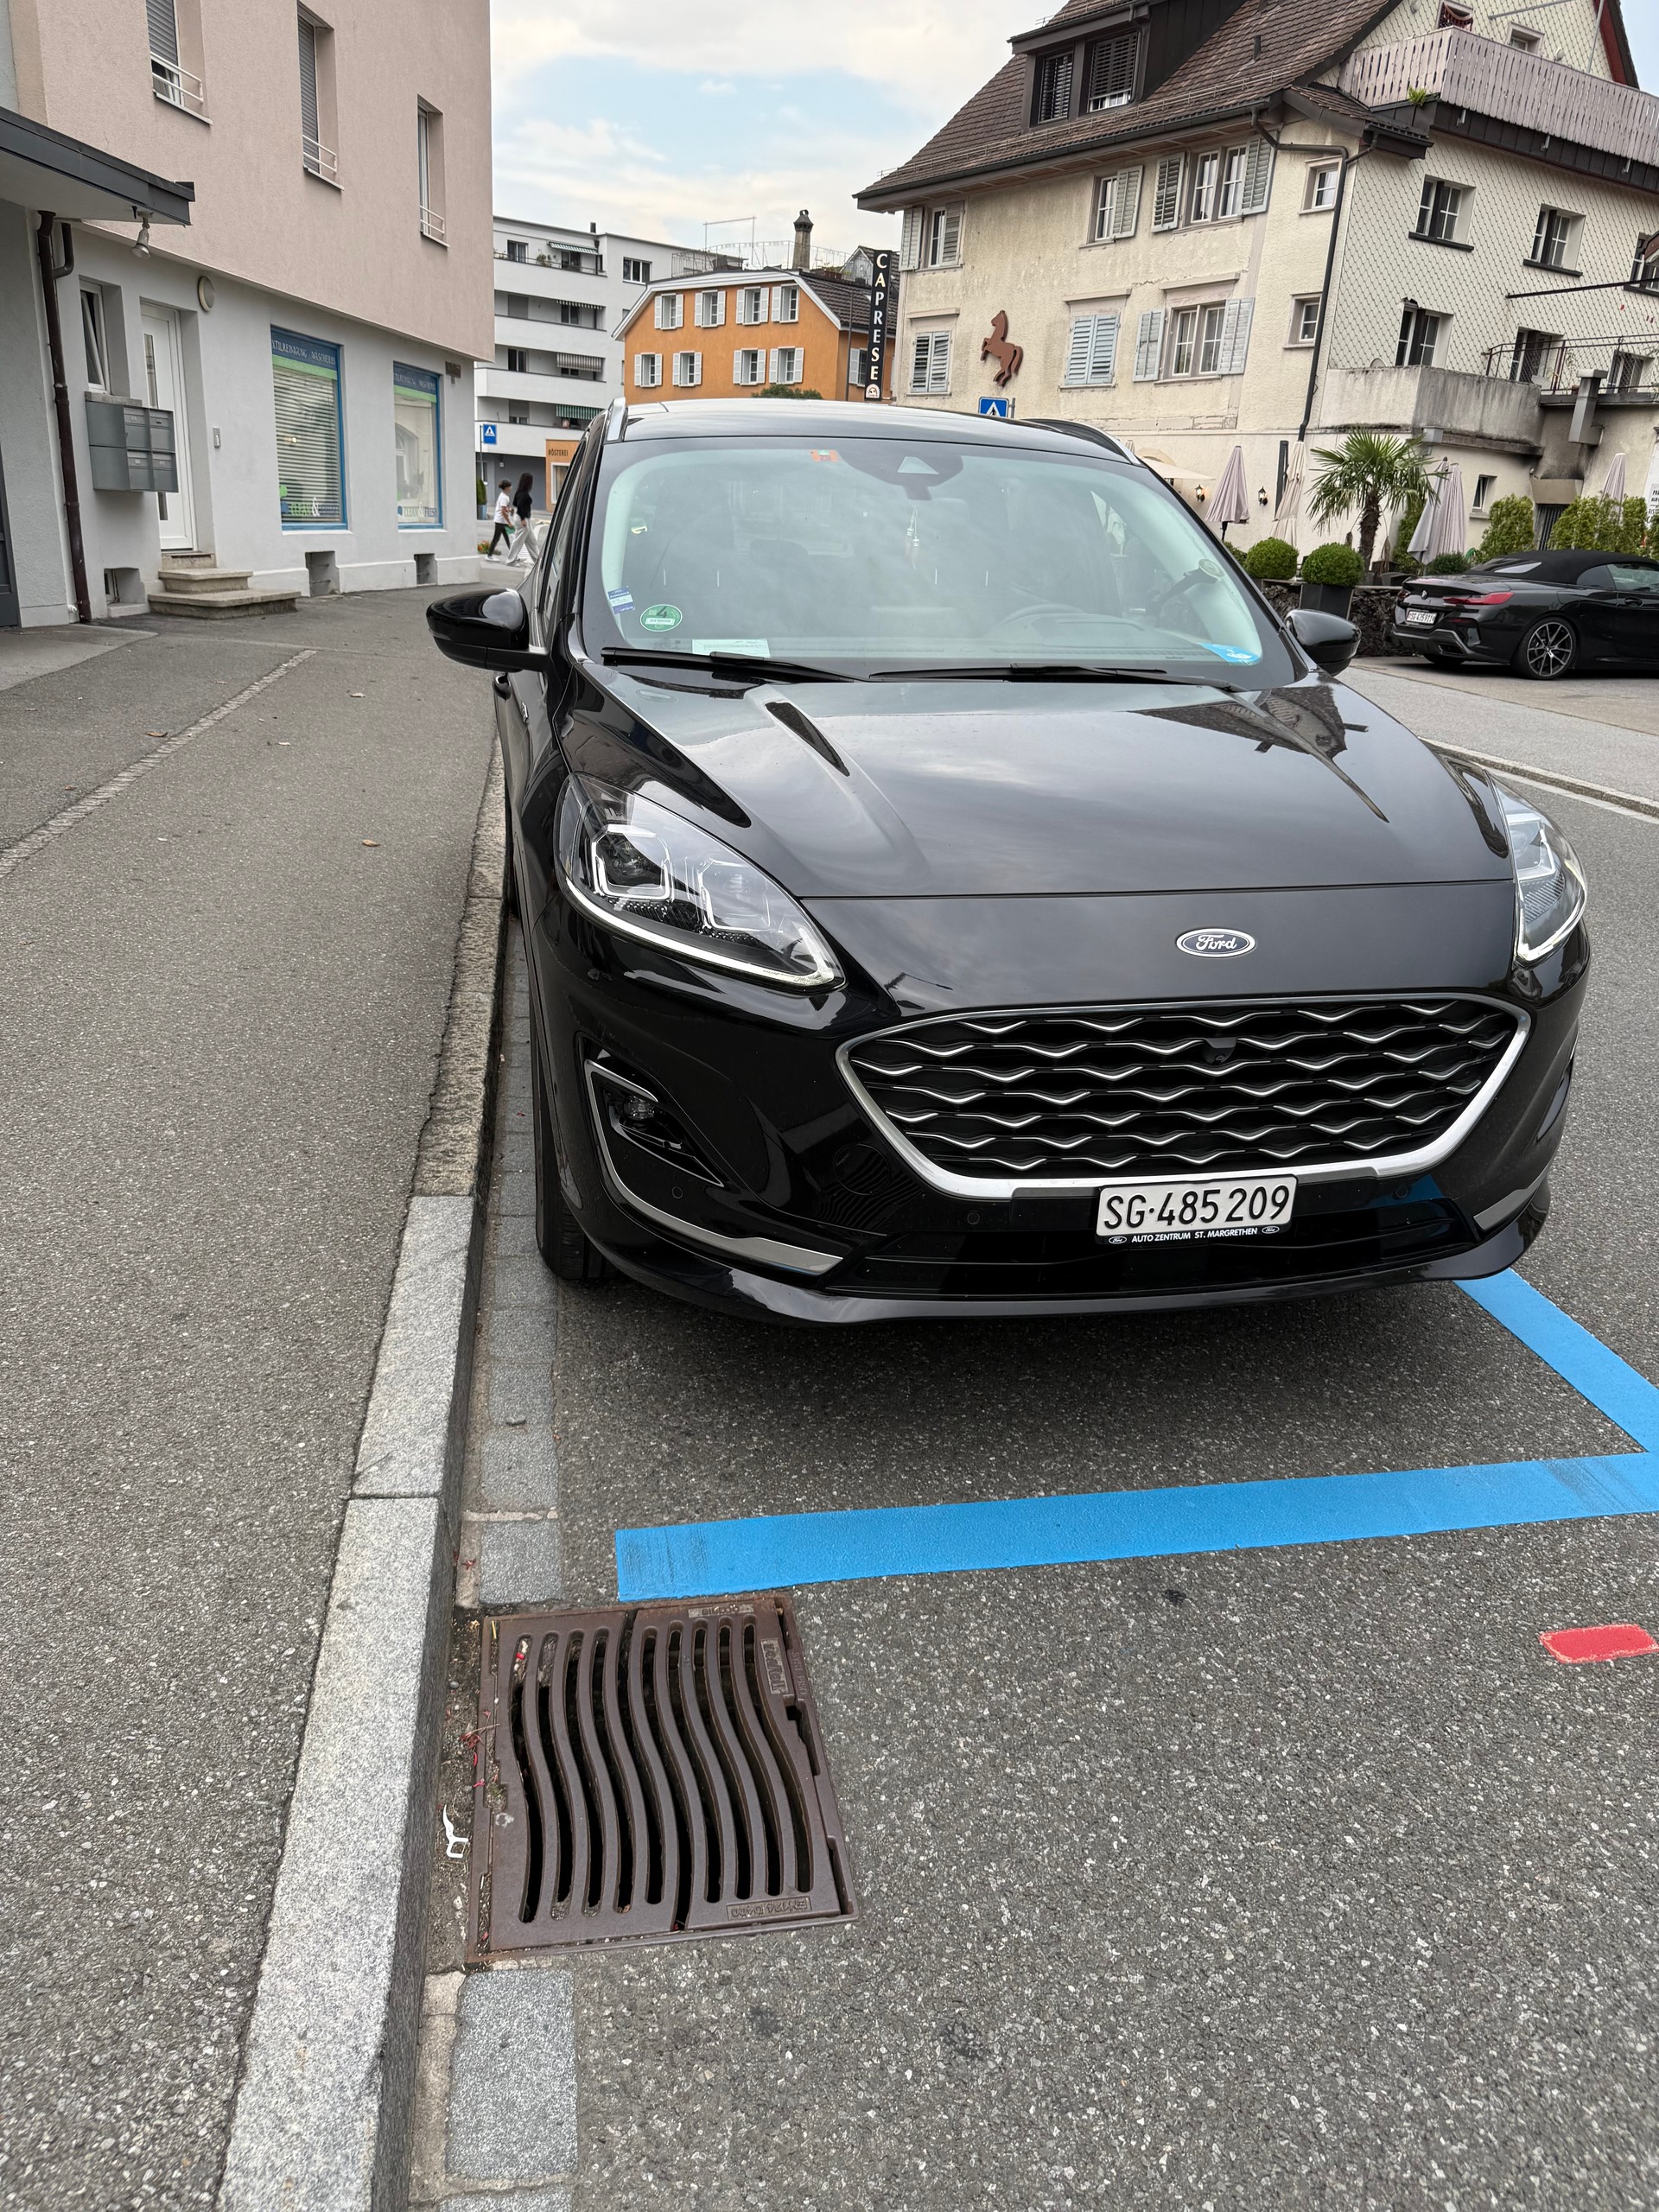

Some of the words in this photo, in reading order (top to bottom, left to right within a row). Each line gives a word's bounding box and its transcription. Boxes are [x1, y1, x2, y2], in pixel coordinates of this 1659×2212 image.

[870, 252, 888, 381] CAPRESE
[548, 448, 569, 457] RÖSTEREI
[656, 607, 668, 618] 4
[1195, 934, 1238, 951] Ford
[1131, 1233, 1154, 1243] AUTO
[1154, 1231, 1192, 1242] ZENTRUM
[1194, 1230, 1206, 1239] ST.
[1207, 1227, 1258, 1238] MARGRETHEN
